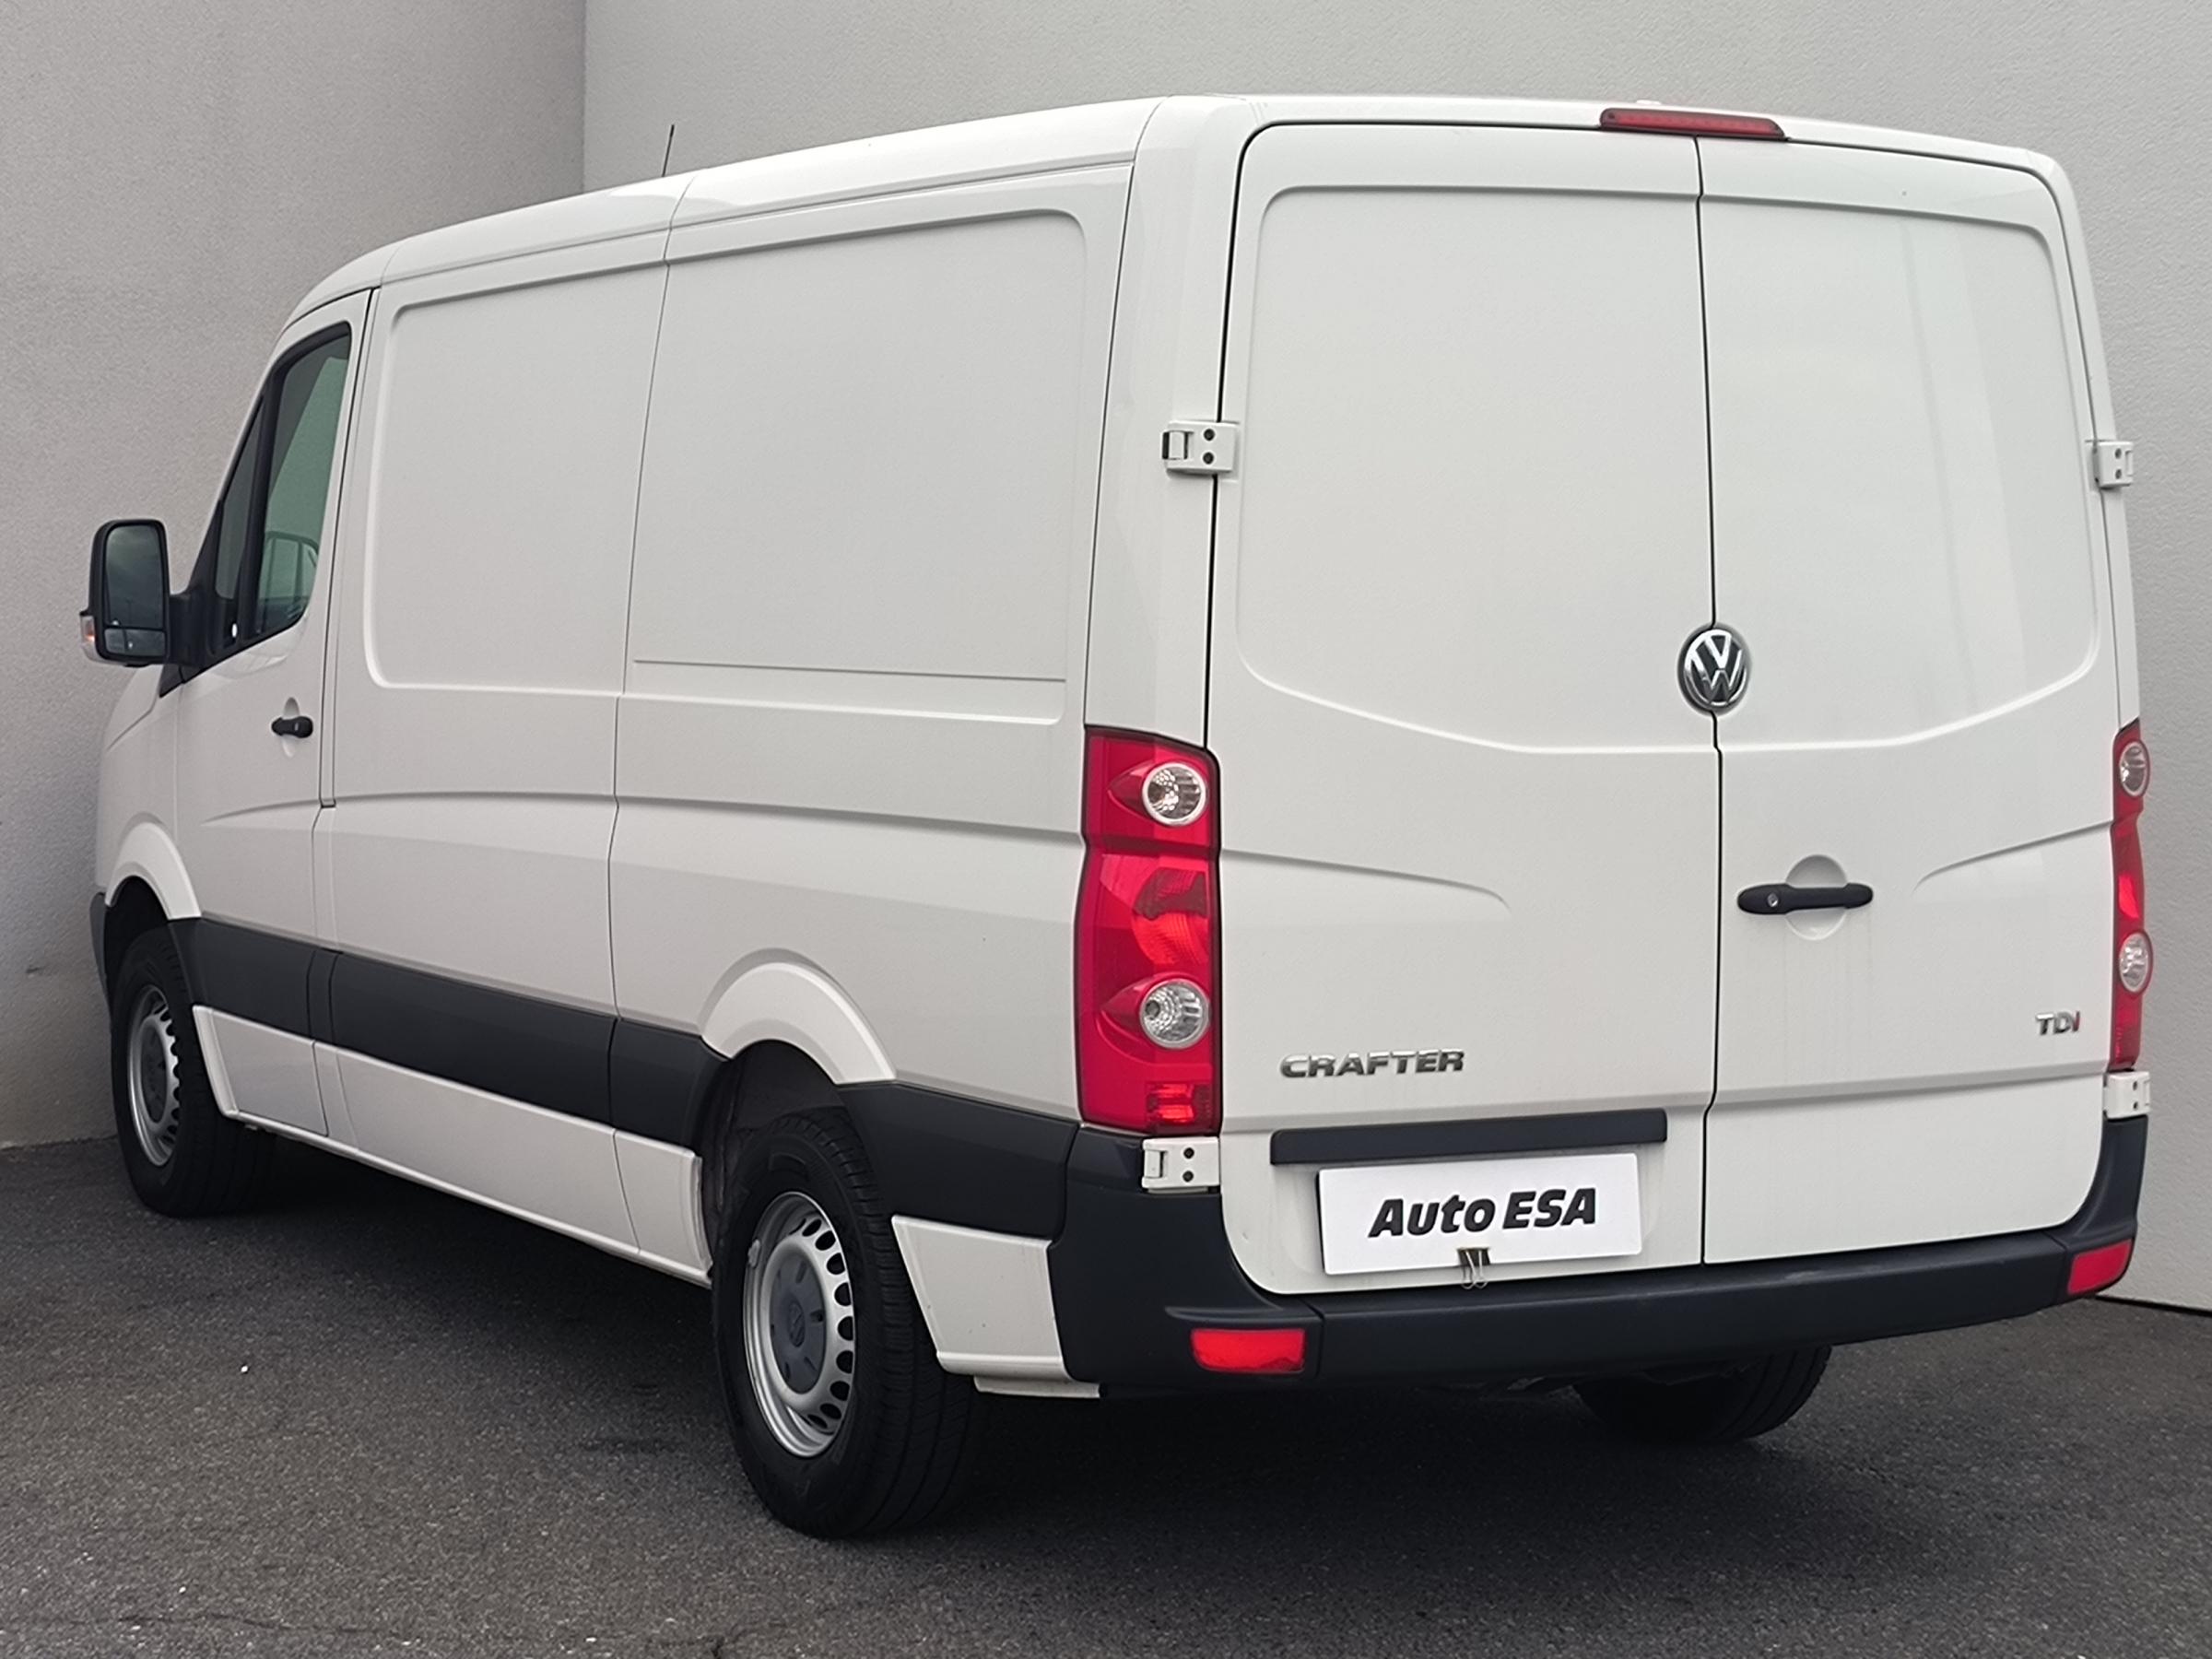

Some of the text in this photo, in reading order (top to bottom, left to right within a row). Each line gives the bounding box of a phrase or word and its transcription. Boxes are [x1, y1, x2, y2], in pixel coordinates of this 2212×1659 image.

[2035, 1010, 2080, 1035] TDI
[1279, 1047, 1465, 1078] CRAFTER
[1367, 1187, 1597, 1239] Auto ESA
